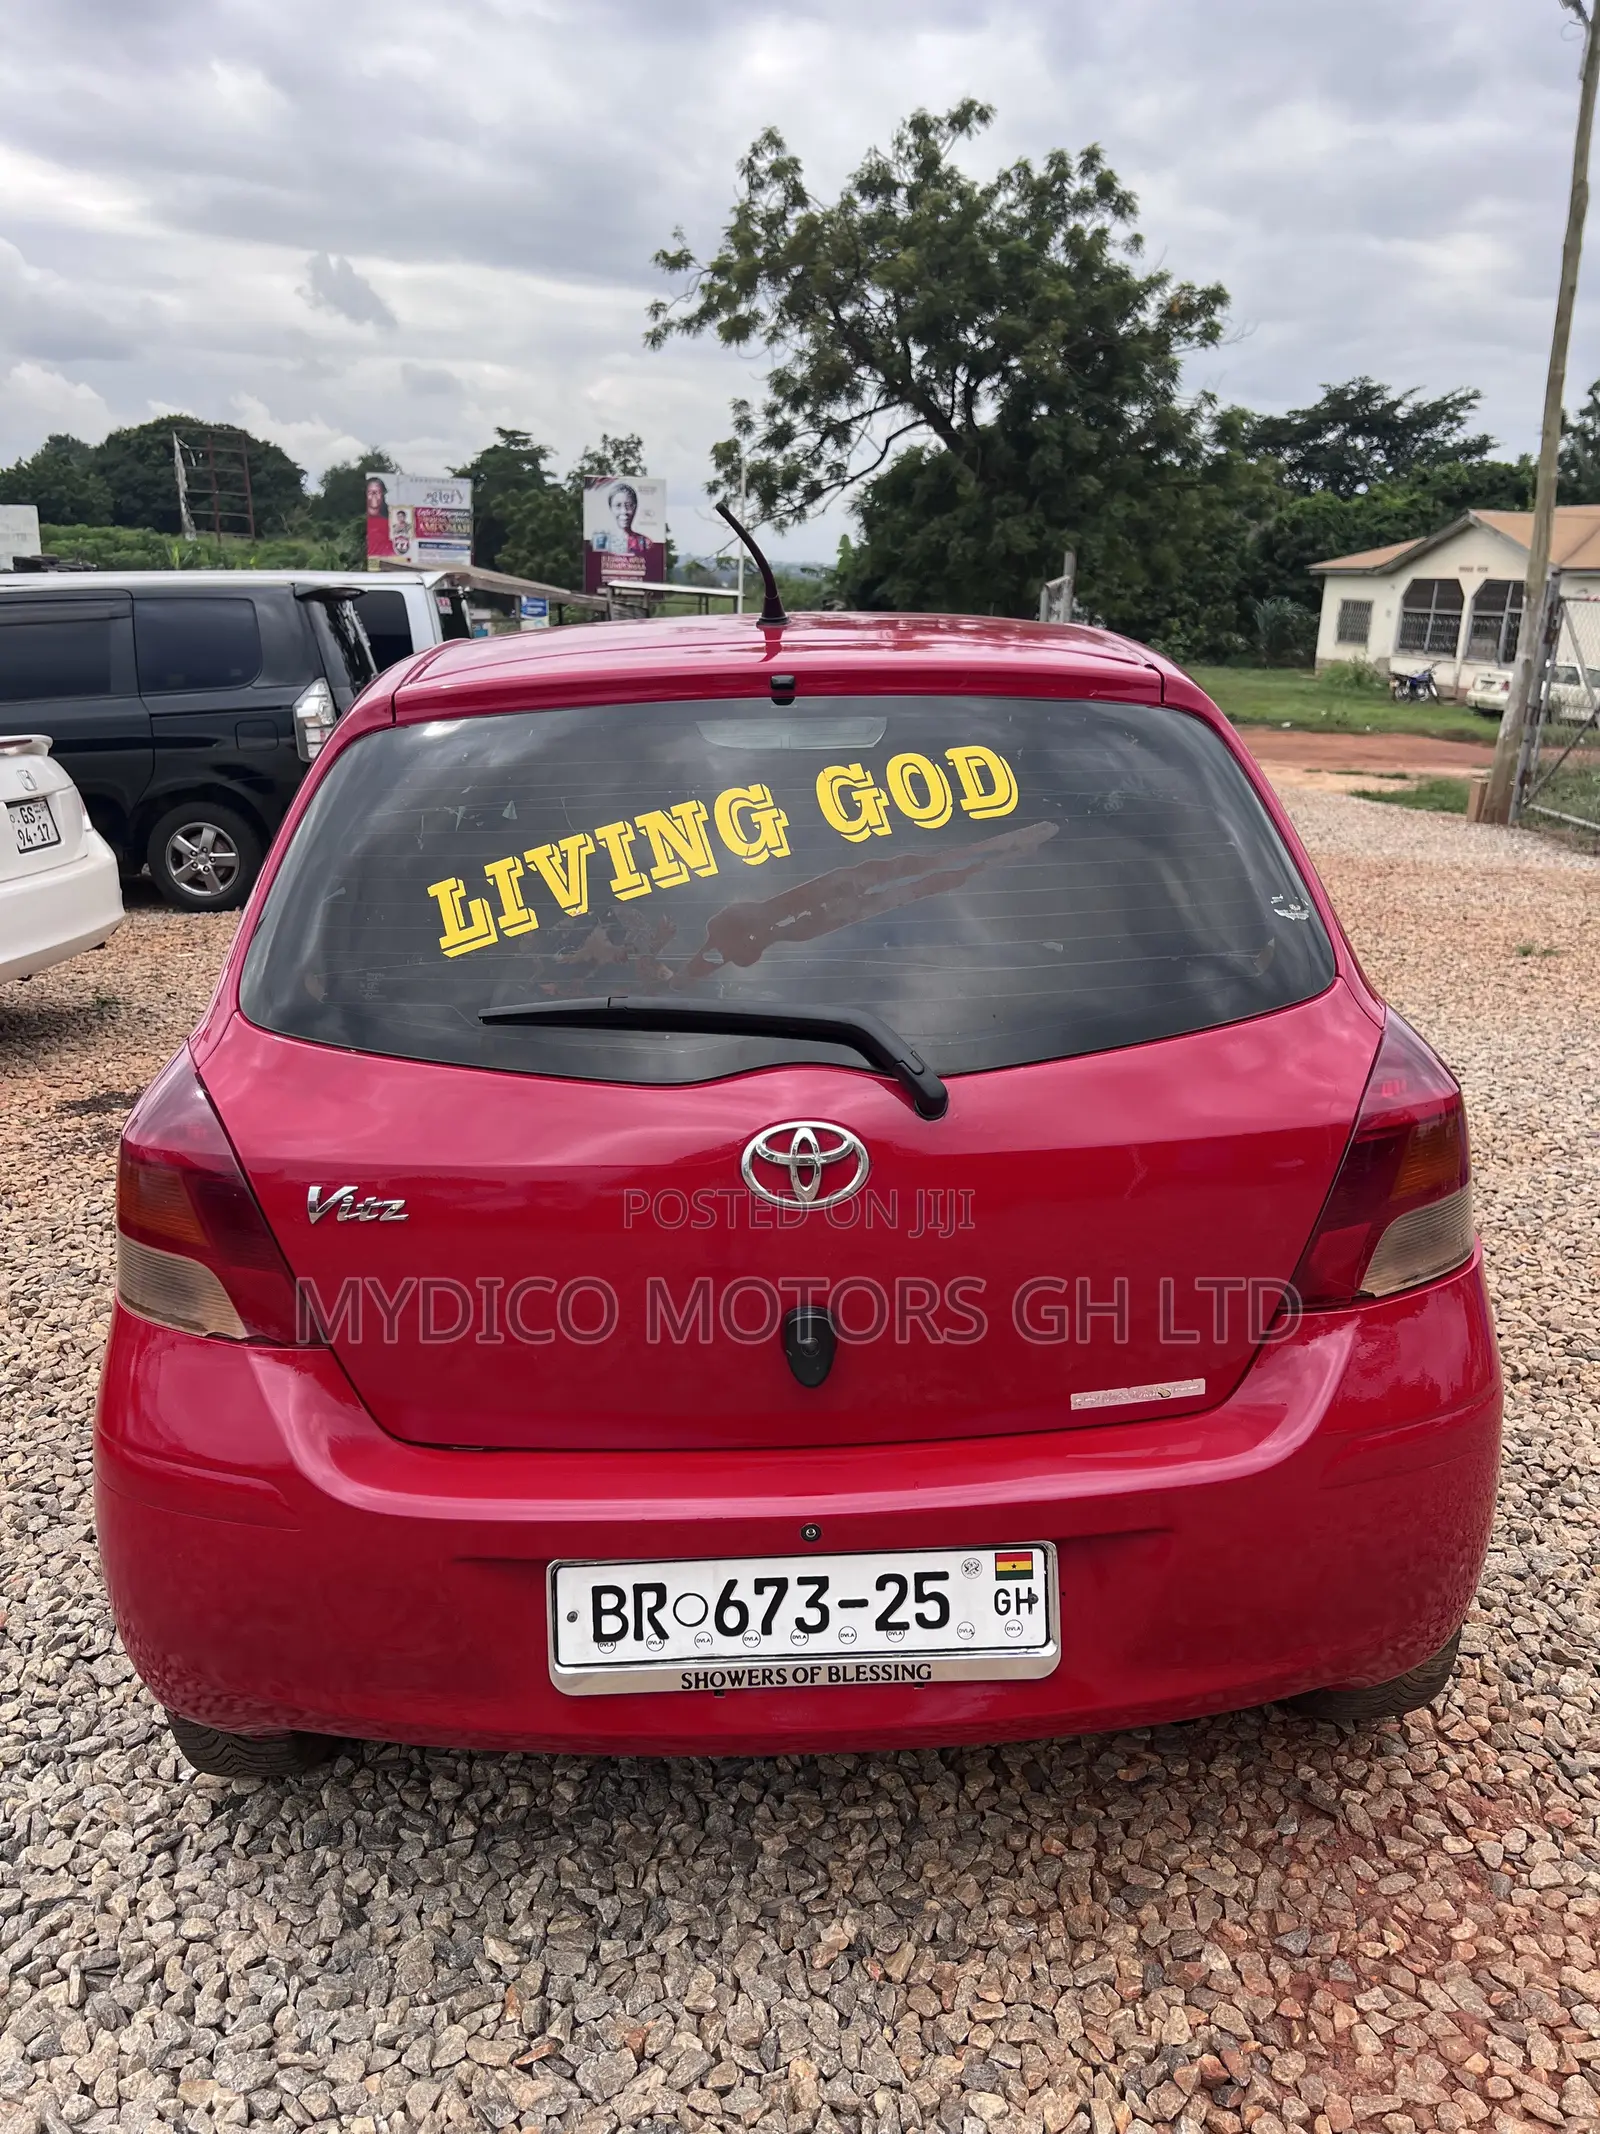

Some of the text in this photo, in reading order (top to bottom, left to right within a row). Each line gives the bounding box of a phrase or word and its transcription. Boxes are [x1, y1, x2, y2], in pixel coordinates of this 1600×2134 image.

[19, 806, 36, 824] GS
[427, 745, 1019, 958] LIVING GOD
[307, 1185, 409, 1225] Vitz
[994, 1586, 1034, 1616] GH
[681, 1663, 932, 1690] SHOWERS OF BLESSING
